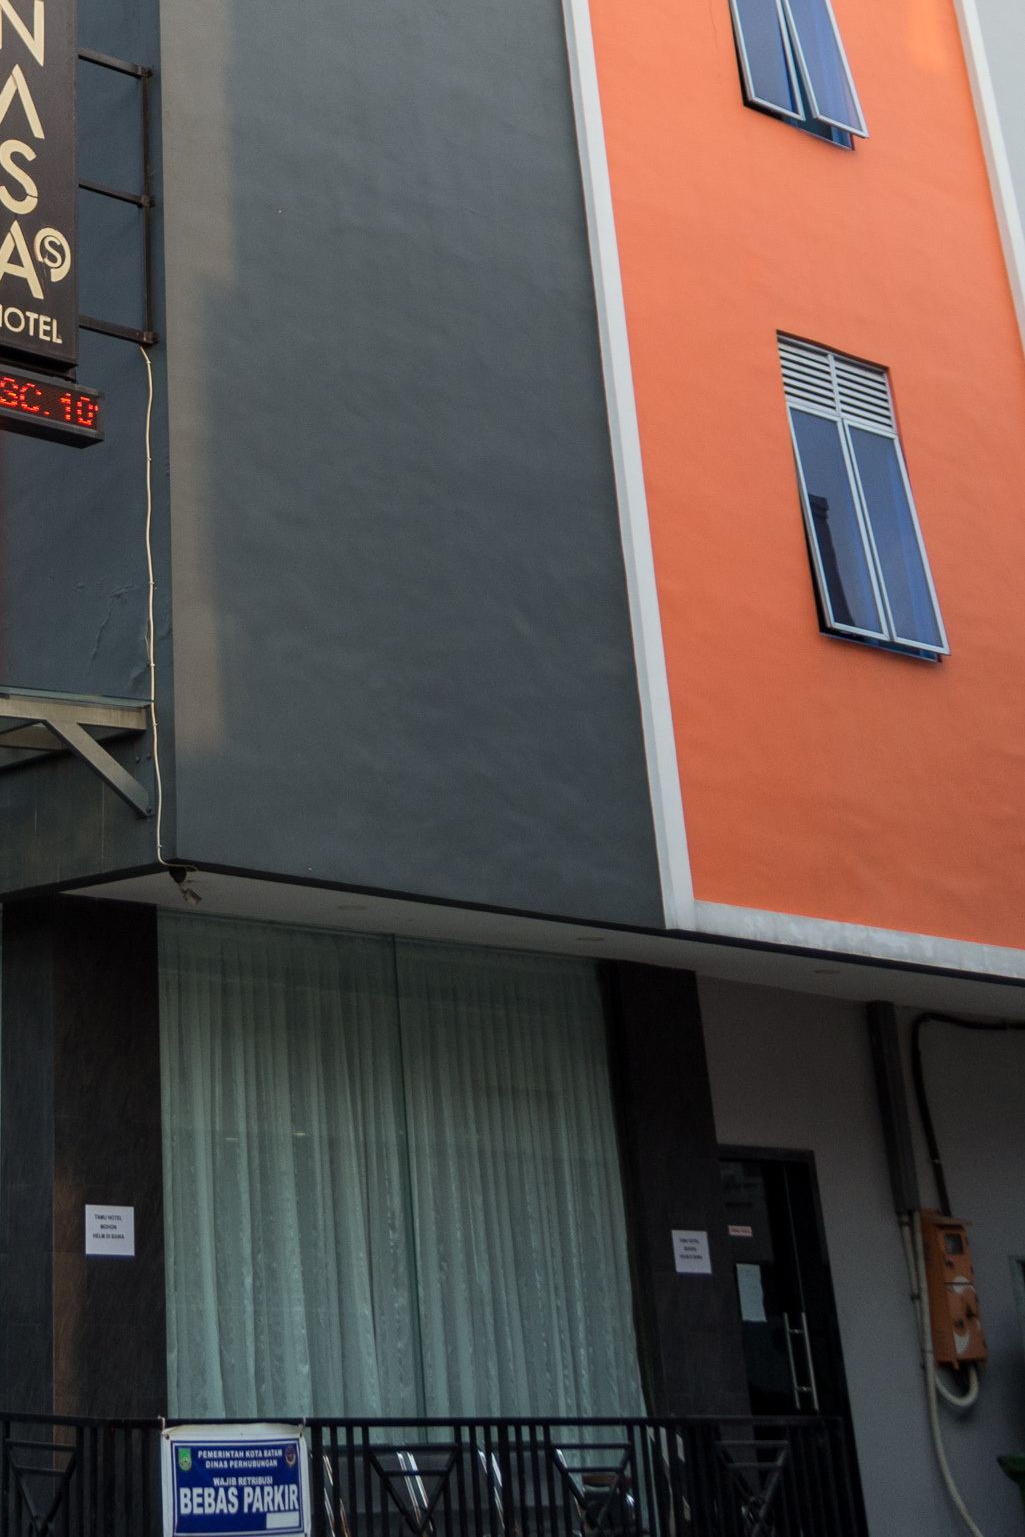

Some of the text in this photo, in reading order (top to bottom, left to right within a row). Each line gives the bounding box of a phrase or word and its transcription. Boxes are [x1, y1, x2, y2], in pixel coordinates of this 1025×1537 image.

[198, 1449, 283, 1458] PEMERINTAH KOTA BATAM
[205, 1459, 278, 1469] DINAS PERHUBUNGAN
[213, 1476, 273, 1486] WAJIB RETRIBUSI
[179, 1484, 299, 1514] BEBAS PARKIR
